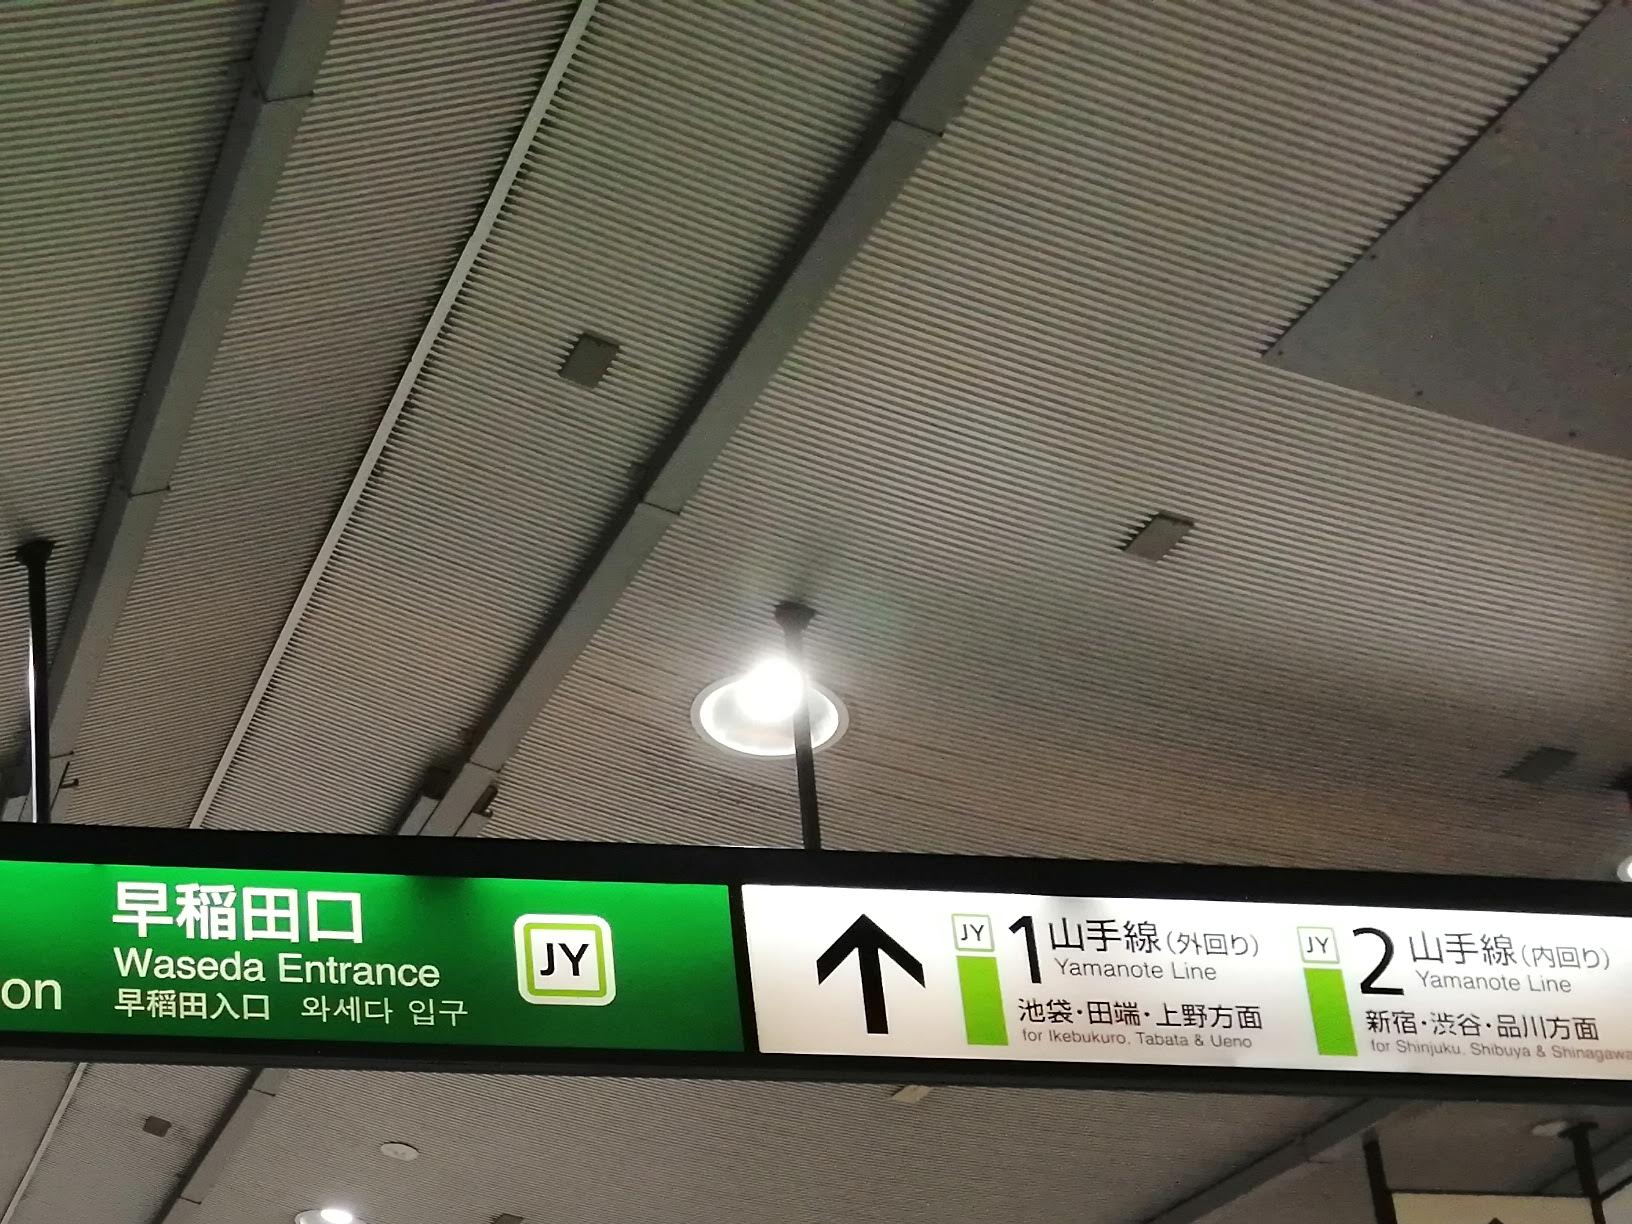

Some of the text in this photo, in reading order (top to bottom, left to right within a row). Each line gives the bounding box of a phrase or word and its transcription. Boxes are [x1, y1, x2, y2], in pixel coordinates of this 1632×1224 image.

[112, 881, 364, 944] 早稲田口
[960, 924, 985, 942] JY
[1305, 936, 1329, 954] JY
[540, 942, 590, 977] JY
[1008, 915, 1042, 984] 1
[1352, 927, 1405, 996] 2
[113, 946, 441, 988] Waseda Entrance
[1054, 958, 1217, 982] Yamanote Line
[1415, 970, 1572, 993] Yamanote Line
[114, 987, 270, 1021] 早稲田入口
[301, 995, 469, 1027] 와세다 입구
[1022, 1028, 1042, 1043] for
[1136, 1032, 1190, 1048] Tabata
[1194, 1034, 1205, 1048] &
[1211, 1034, 1253, 1049] Ueno
[1371, 1039, 1391, 1053] for
[1471, 1042, 1532, 1059] Shibuya
[1536, 1044, 1546, 1058] &
